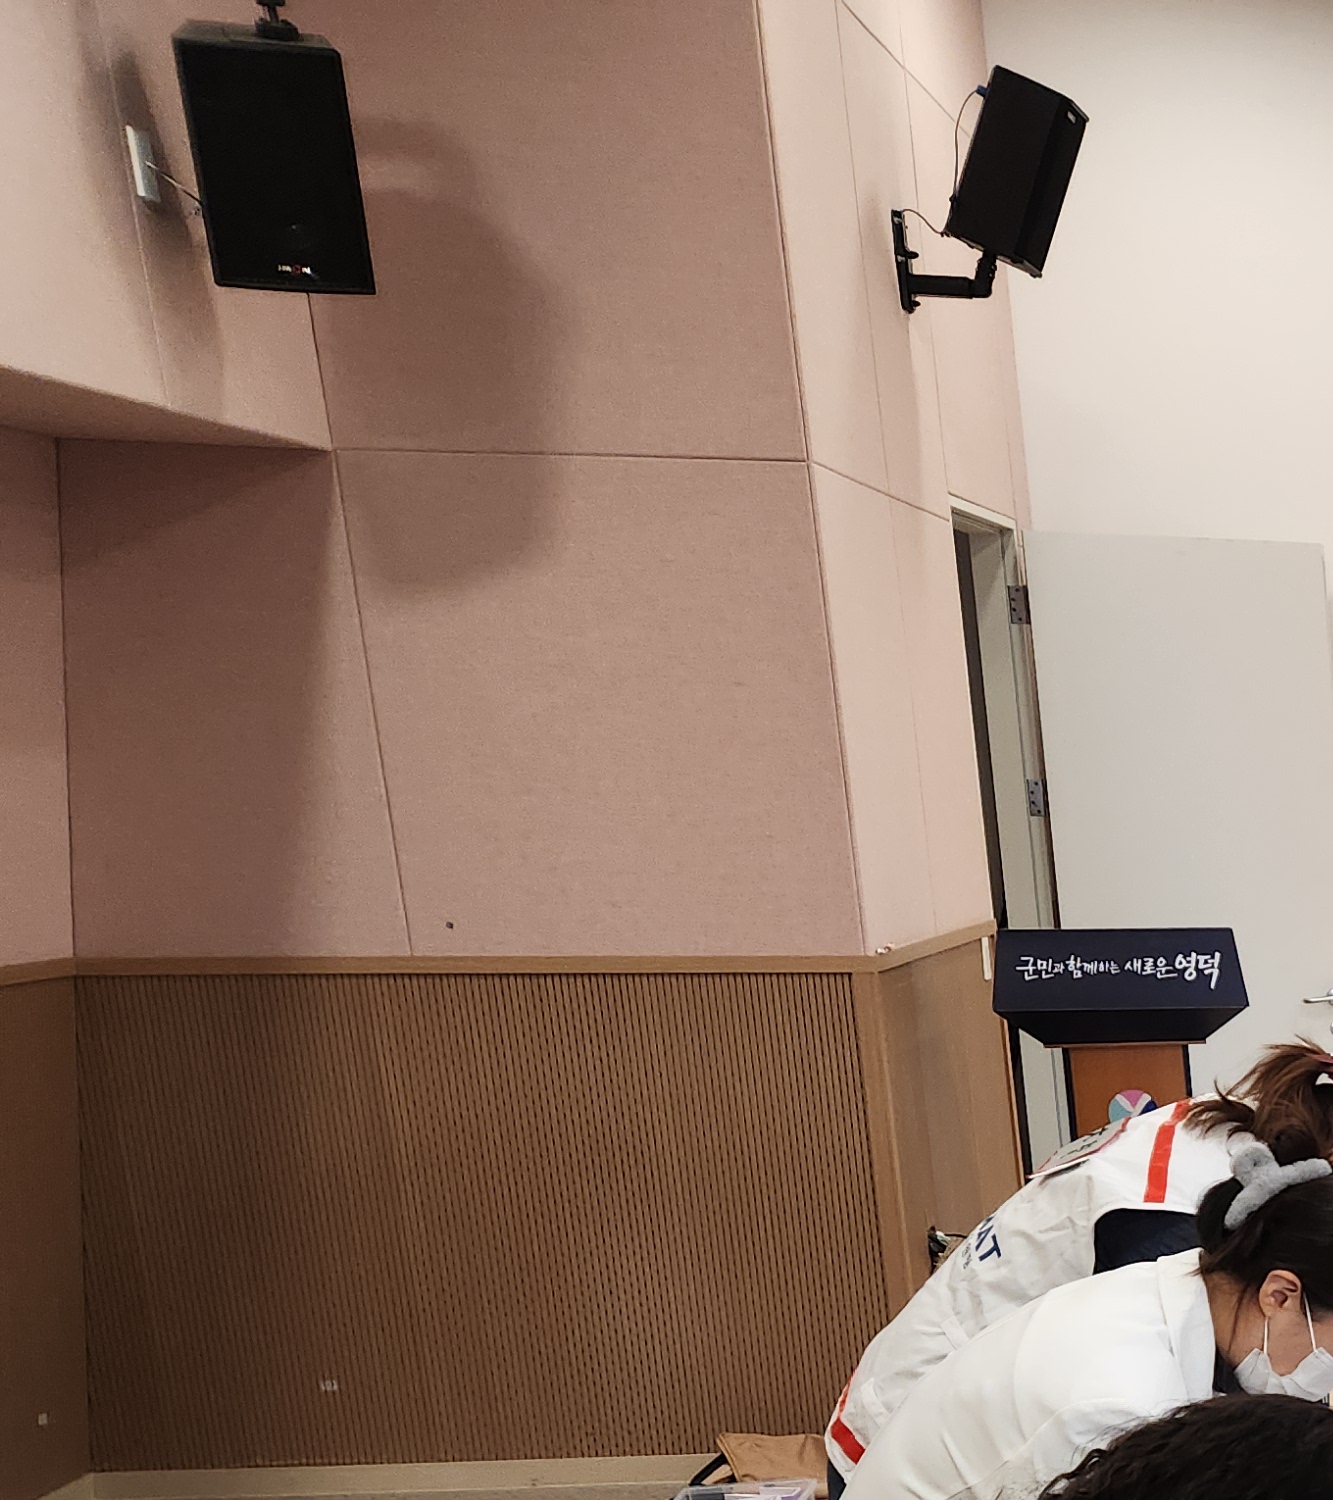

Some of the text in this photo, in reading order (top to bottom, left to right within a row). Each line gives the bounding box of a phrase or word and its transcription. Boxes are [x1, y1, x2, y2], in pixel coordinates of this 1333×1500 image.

[1015, 950, 1222, 990] 군민과 함께하는 새로운 영덕
